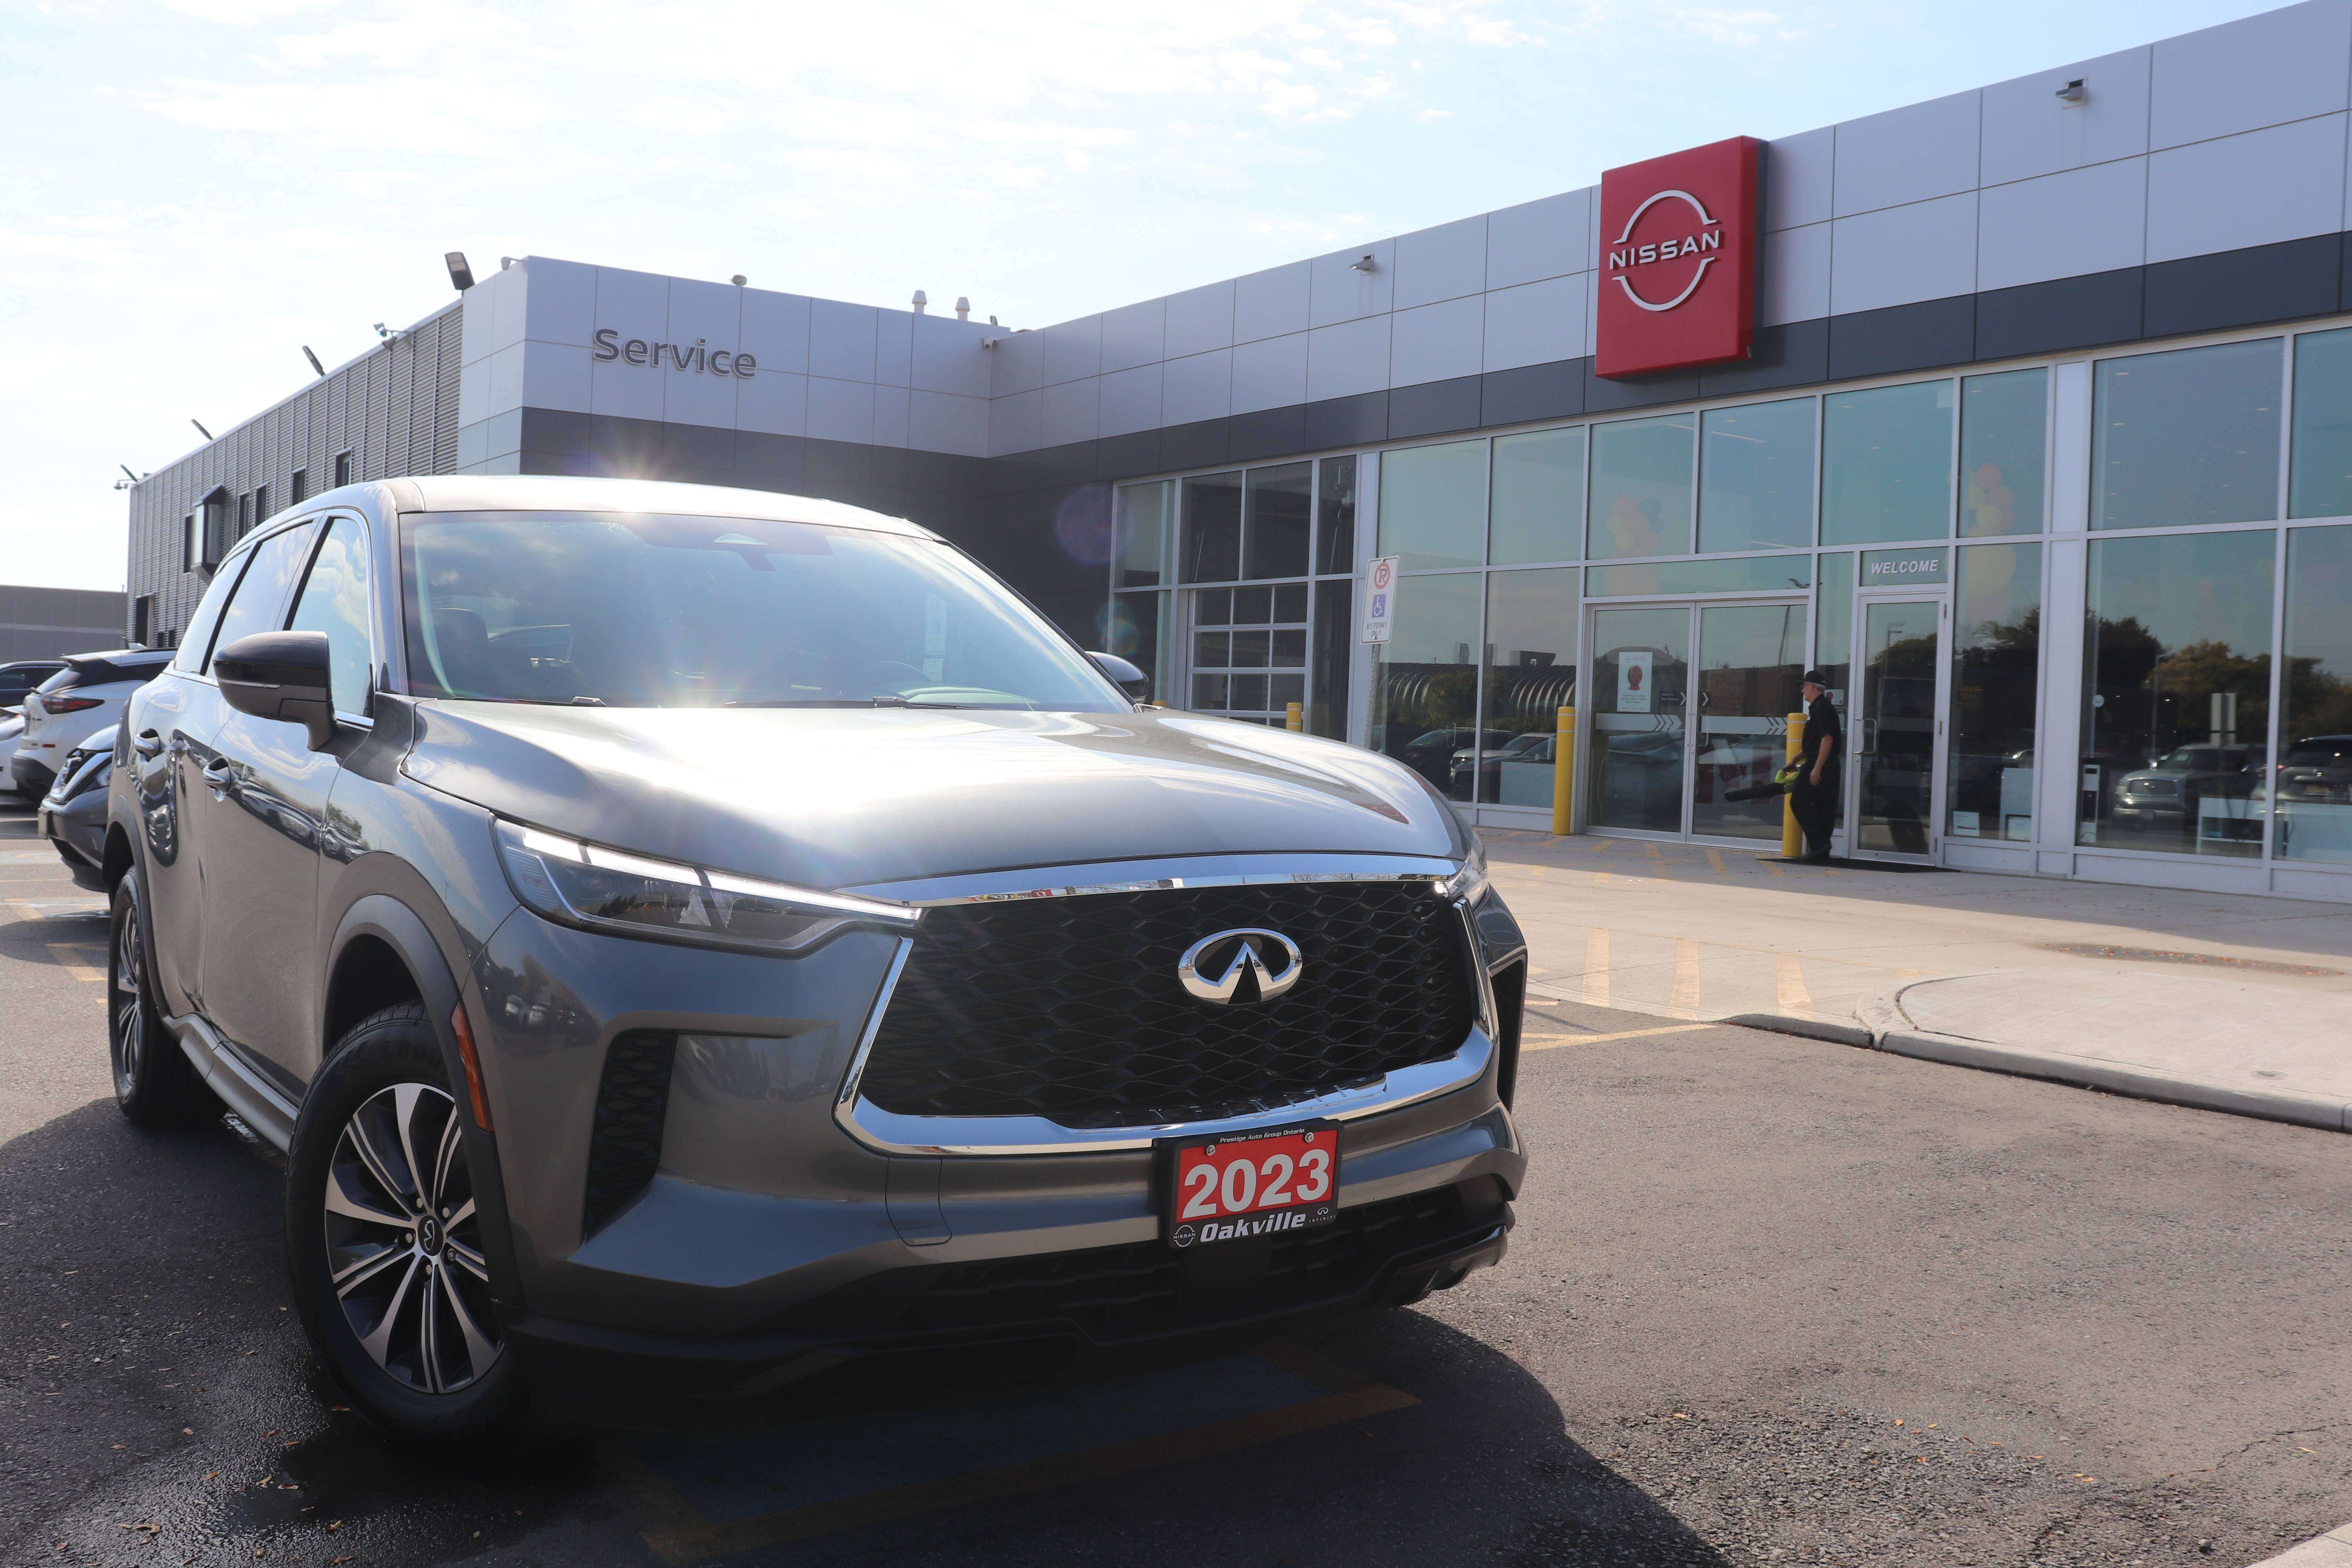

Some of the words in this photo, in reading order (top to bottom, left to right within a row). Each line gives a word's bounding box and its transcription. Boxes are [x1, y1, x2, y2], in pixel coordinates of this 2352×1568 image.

[1609, 229, 1720, 270] NISSAN
[593, 328, 757, 379] Service
[1871, 559, 1939, 574] WELCOME
[1182, 1149, 1330, 1219] 2023
[1200, 1211, 1306, 1243] Oakville
[1309, 1215, 1336, 1223] INFINITI
